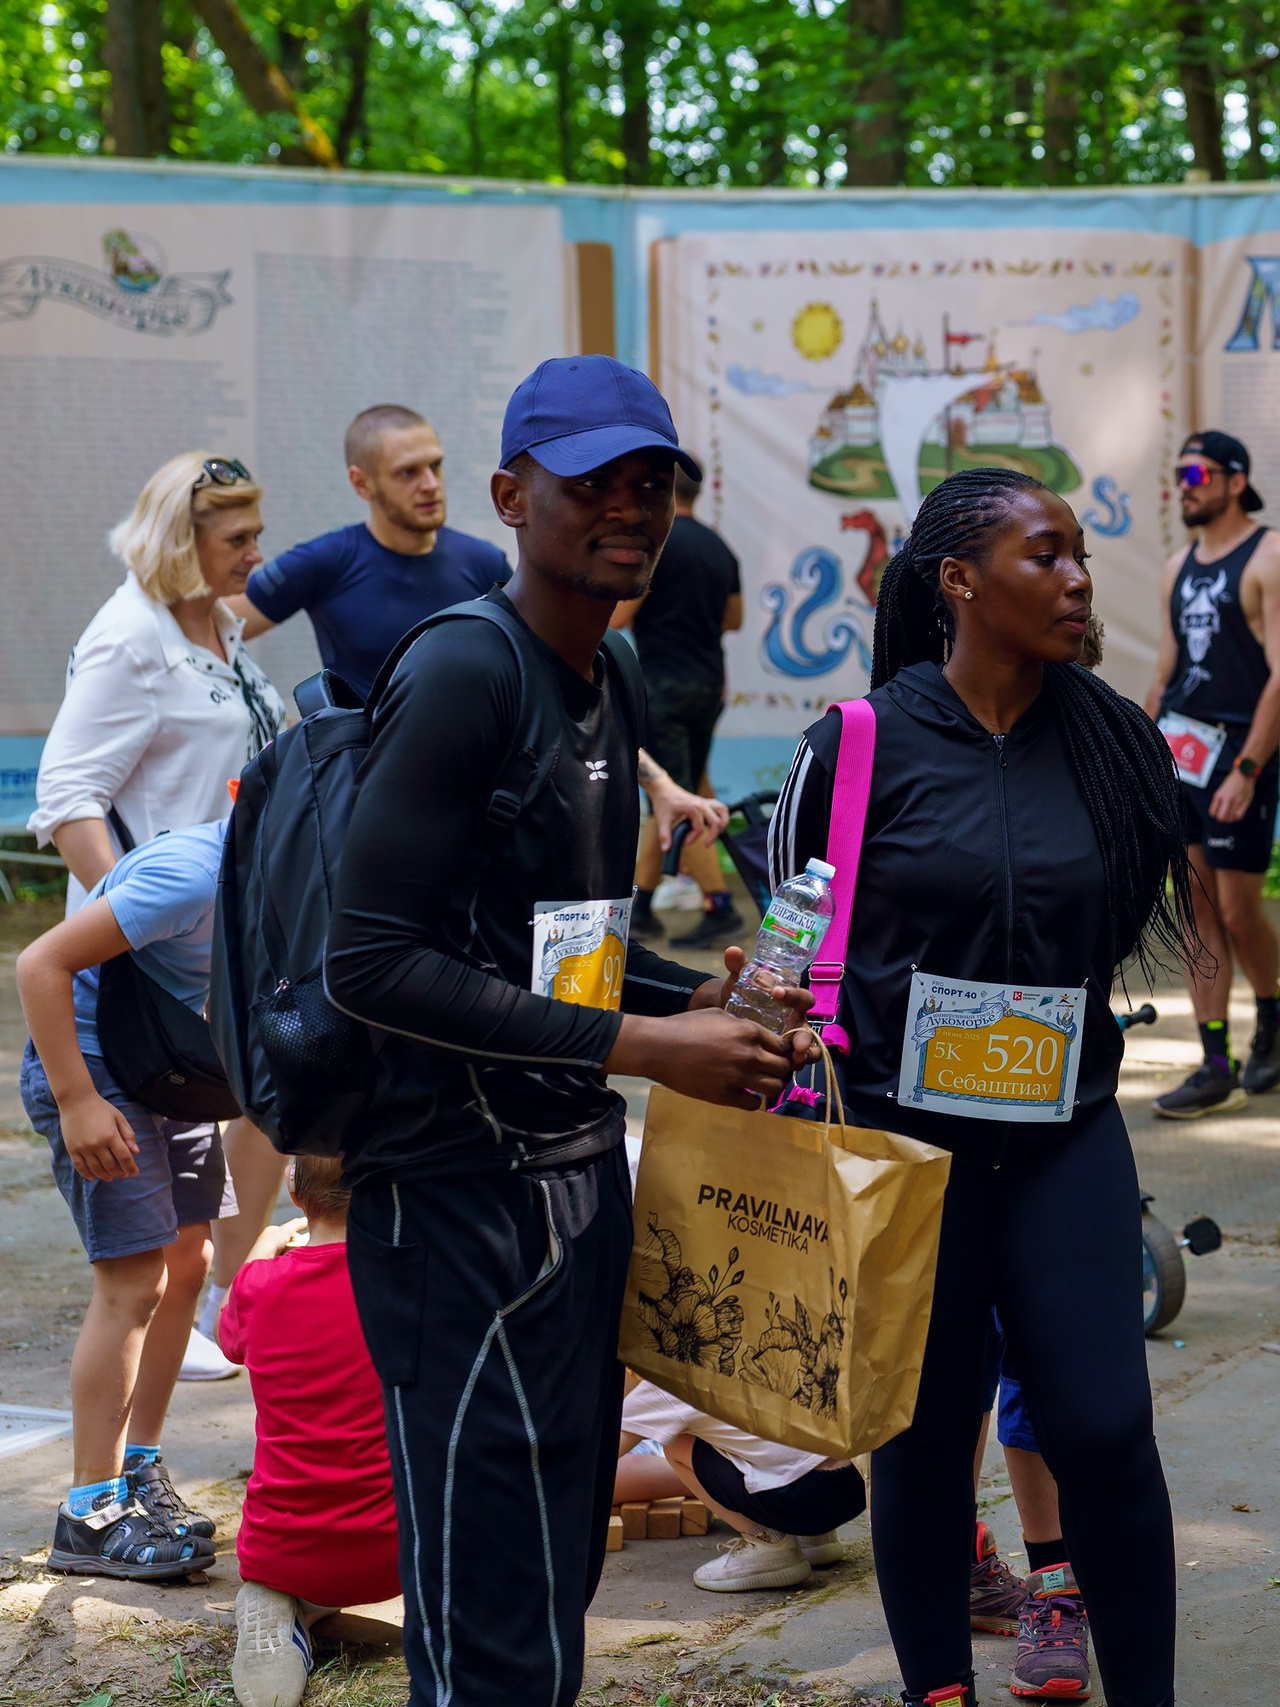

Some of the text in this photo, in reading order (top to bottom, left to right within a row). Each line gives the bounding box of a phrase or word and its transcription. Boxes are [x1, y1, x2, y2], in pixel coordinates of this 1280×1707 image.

[553, 913, 590, 922] СПОРТ 40
[931, 986, 977, 999] СПОРТ 40
[925, 1013, 997, 1029] Лукоморье
[964, 1032, 981, 1041] 2025
[982, 1033, 1058, 1076] 520
[938, 1069, 1053, 1101] Себаштиау
[727, 1214, 808, 1255] KOSMETIKA
